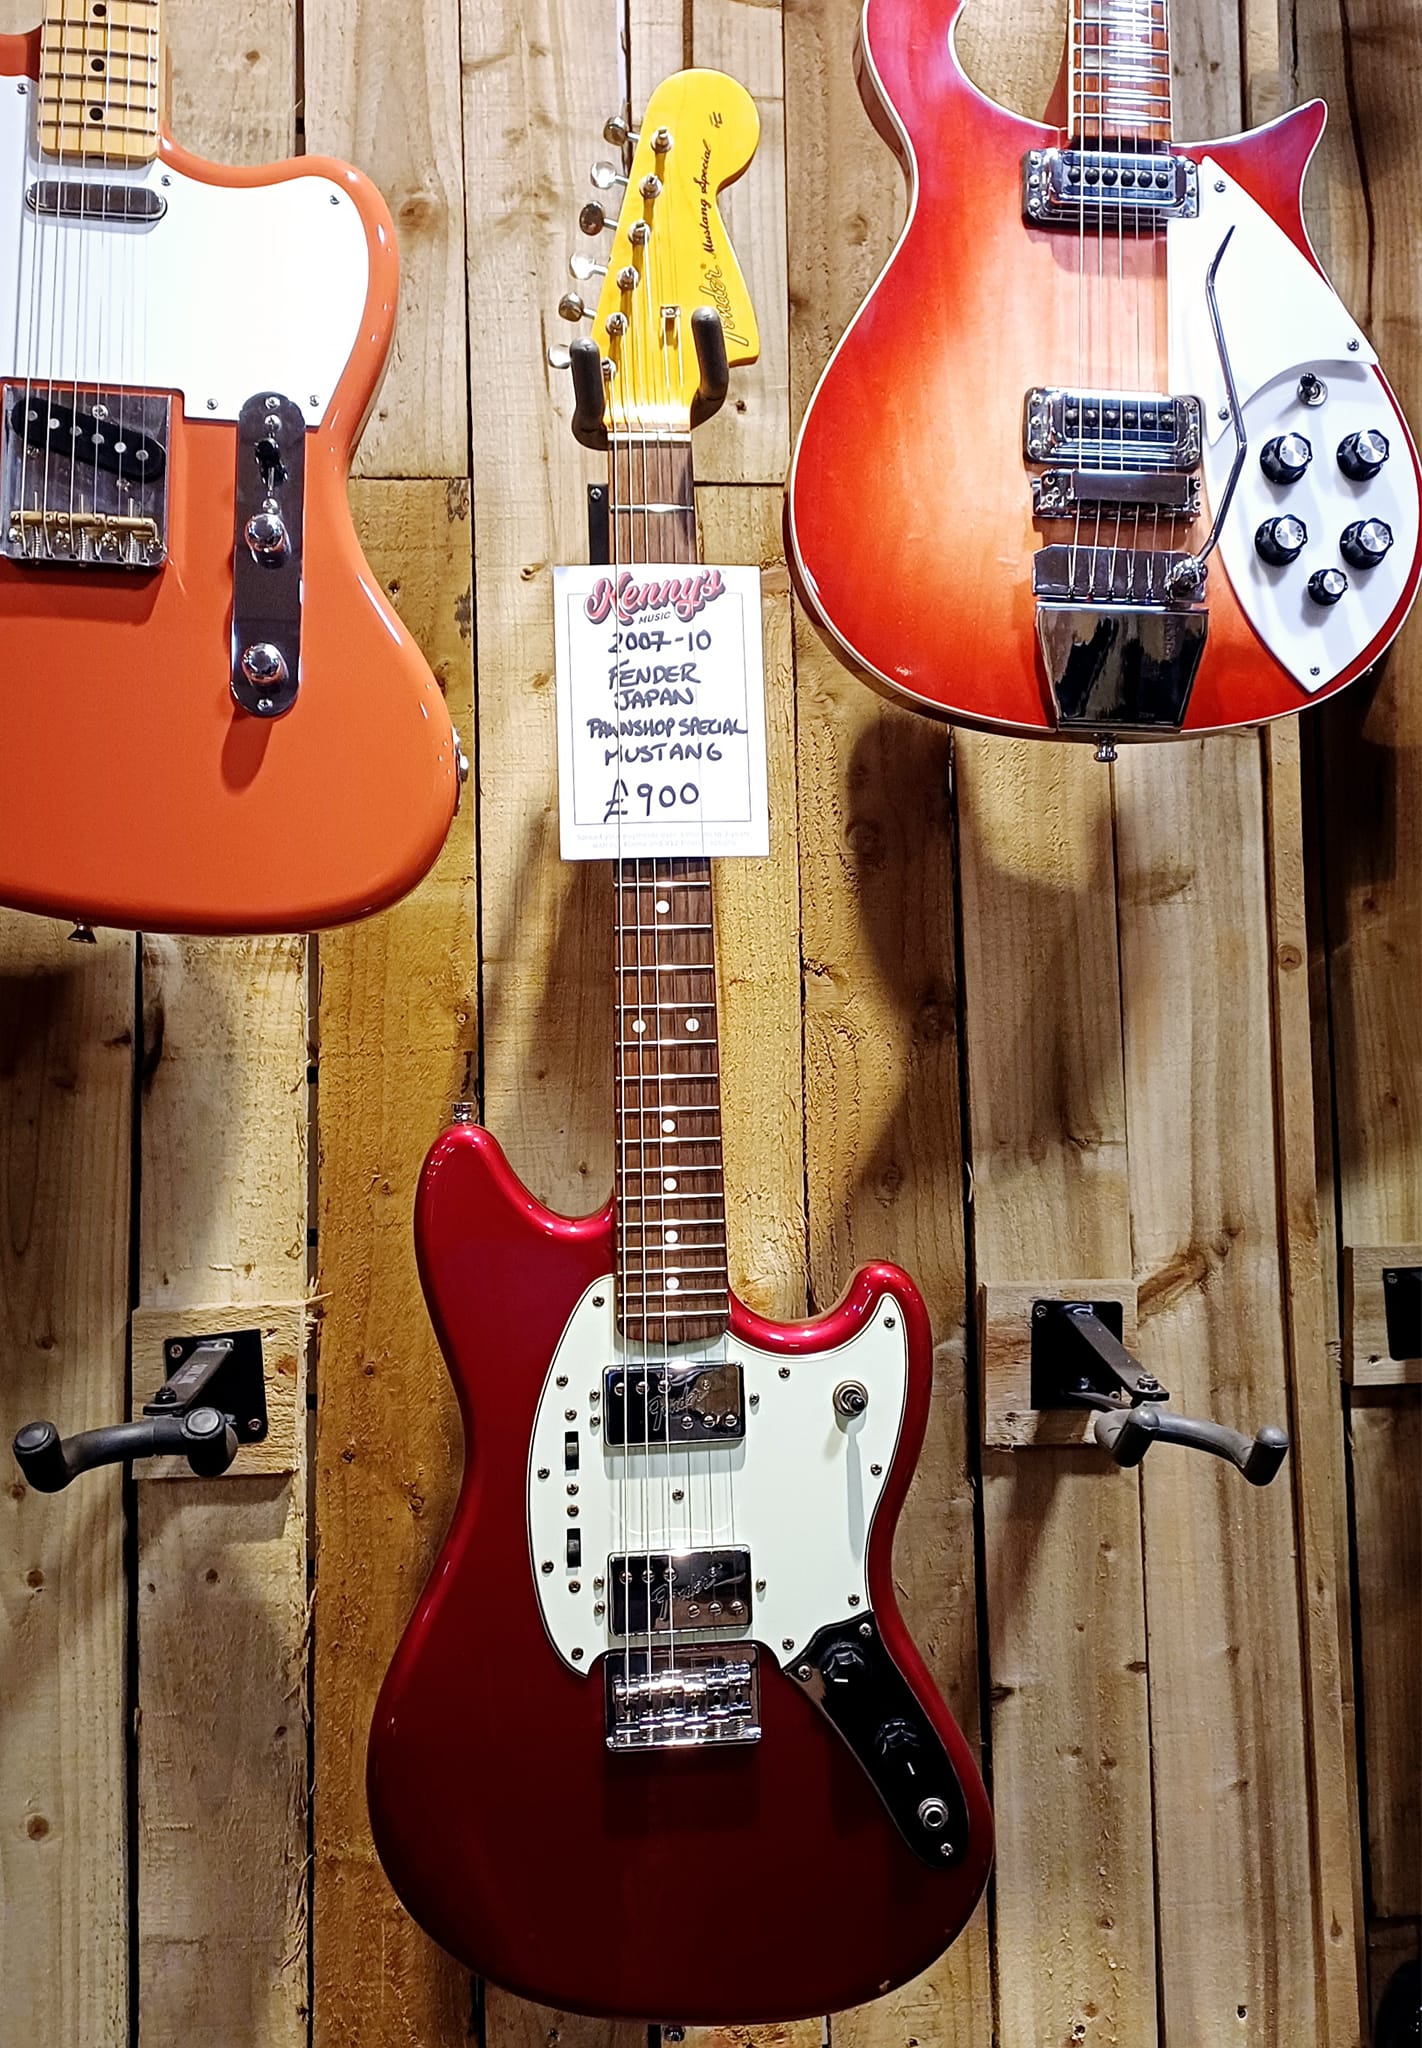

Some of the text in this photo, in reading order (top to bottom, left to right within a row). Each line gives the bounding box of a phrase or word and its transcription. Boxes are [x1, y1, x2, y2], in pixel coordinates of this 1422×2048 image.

[693, 138, 716, 260] Mustang Special
[584, 569, 726, 626] Kenny's
[638, 611, 672, 624] MUSIC
[608, 629, 712, 653] 2007-10
[608, 659, 702, 690] FENDER
[614, 687, 694, 711] JAPAN
[586, 716, 749, 739] PAWNSHOP SPECIAL
[604, 742, 723, 766] MUSTANG
[603, 778, 700, 823] £900
